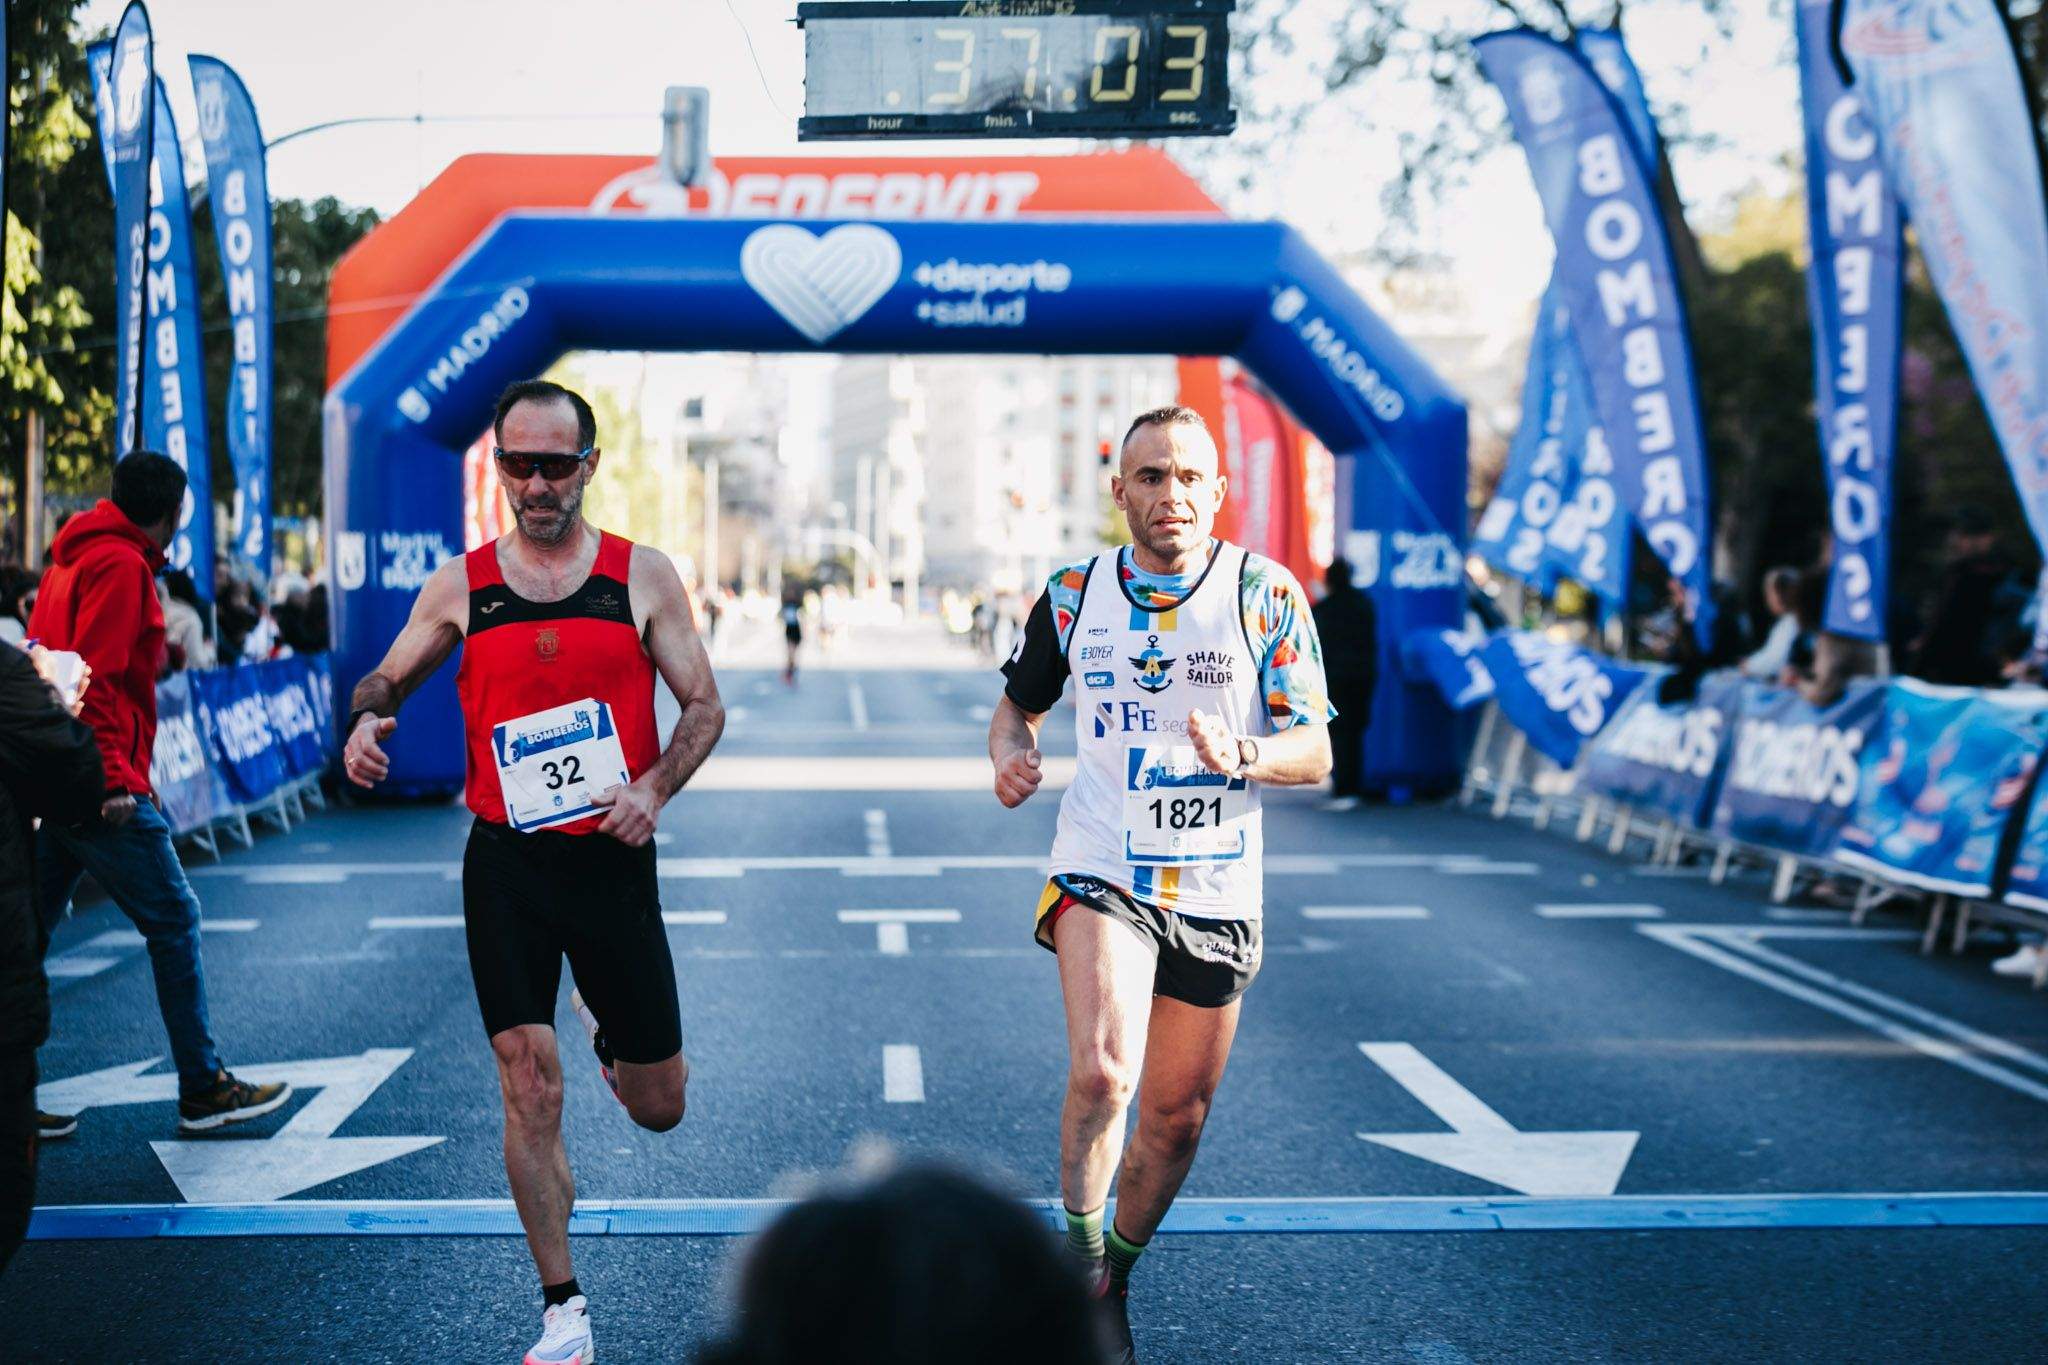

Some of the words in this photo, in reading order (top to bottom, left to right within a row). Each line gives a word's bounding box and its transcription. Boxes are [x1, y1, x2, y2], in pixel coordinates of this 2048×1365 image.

[867, 117, 902, 130] hour
[1169, 111, 1200, 124] sec.
[1186, 651, 1236, 668] SHAVE
[1186, 668, 1234, 684] SAILOR
[526, 719, 590, 745] BOMBEROS
[1162, 719, 1190, 737] seg
[541, 755, 585, 790] 32
[1149, 797, 1222, 829] 1821
